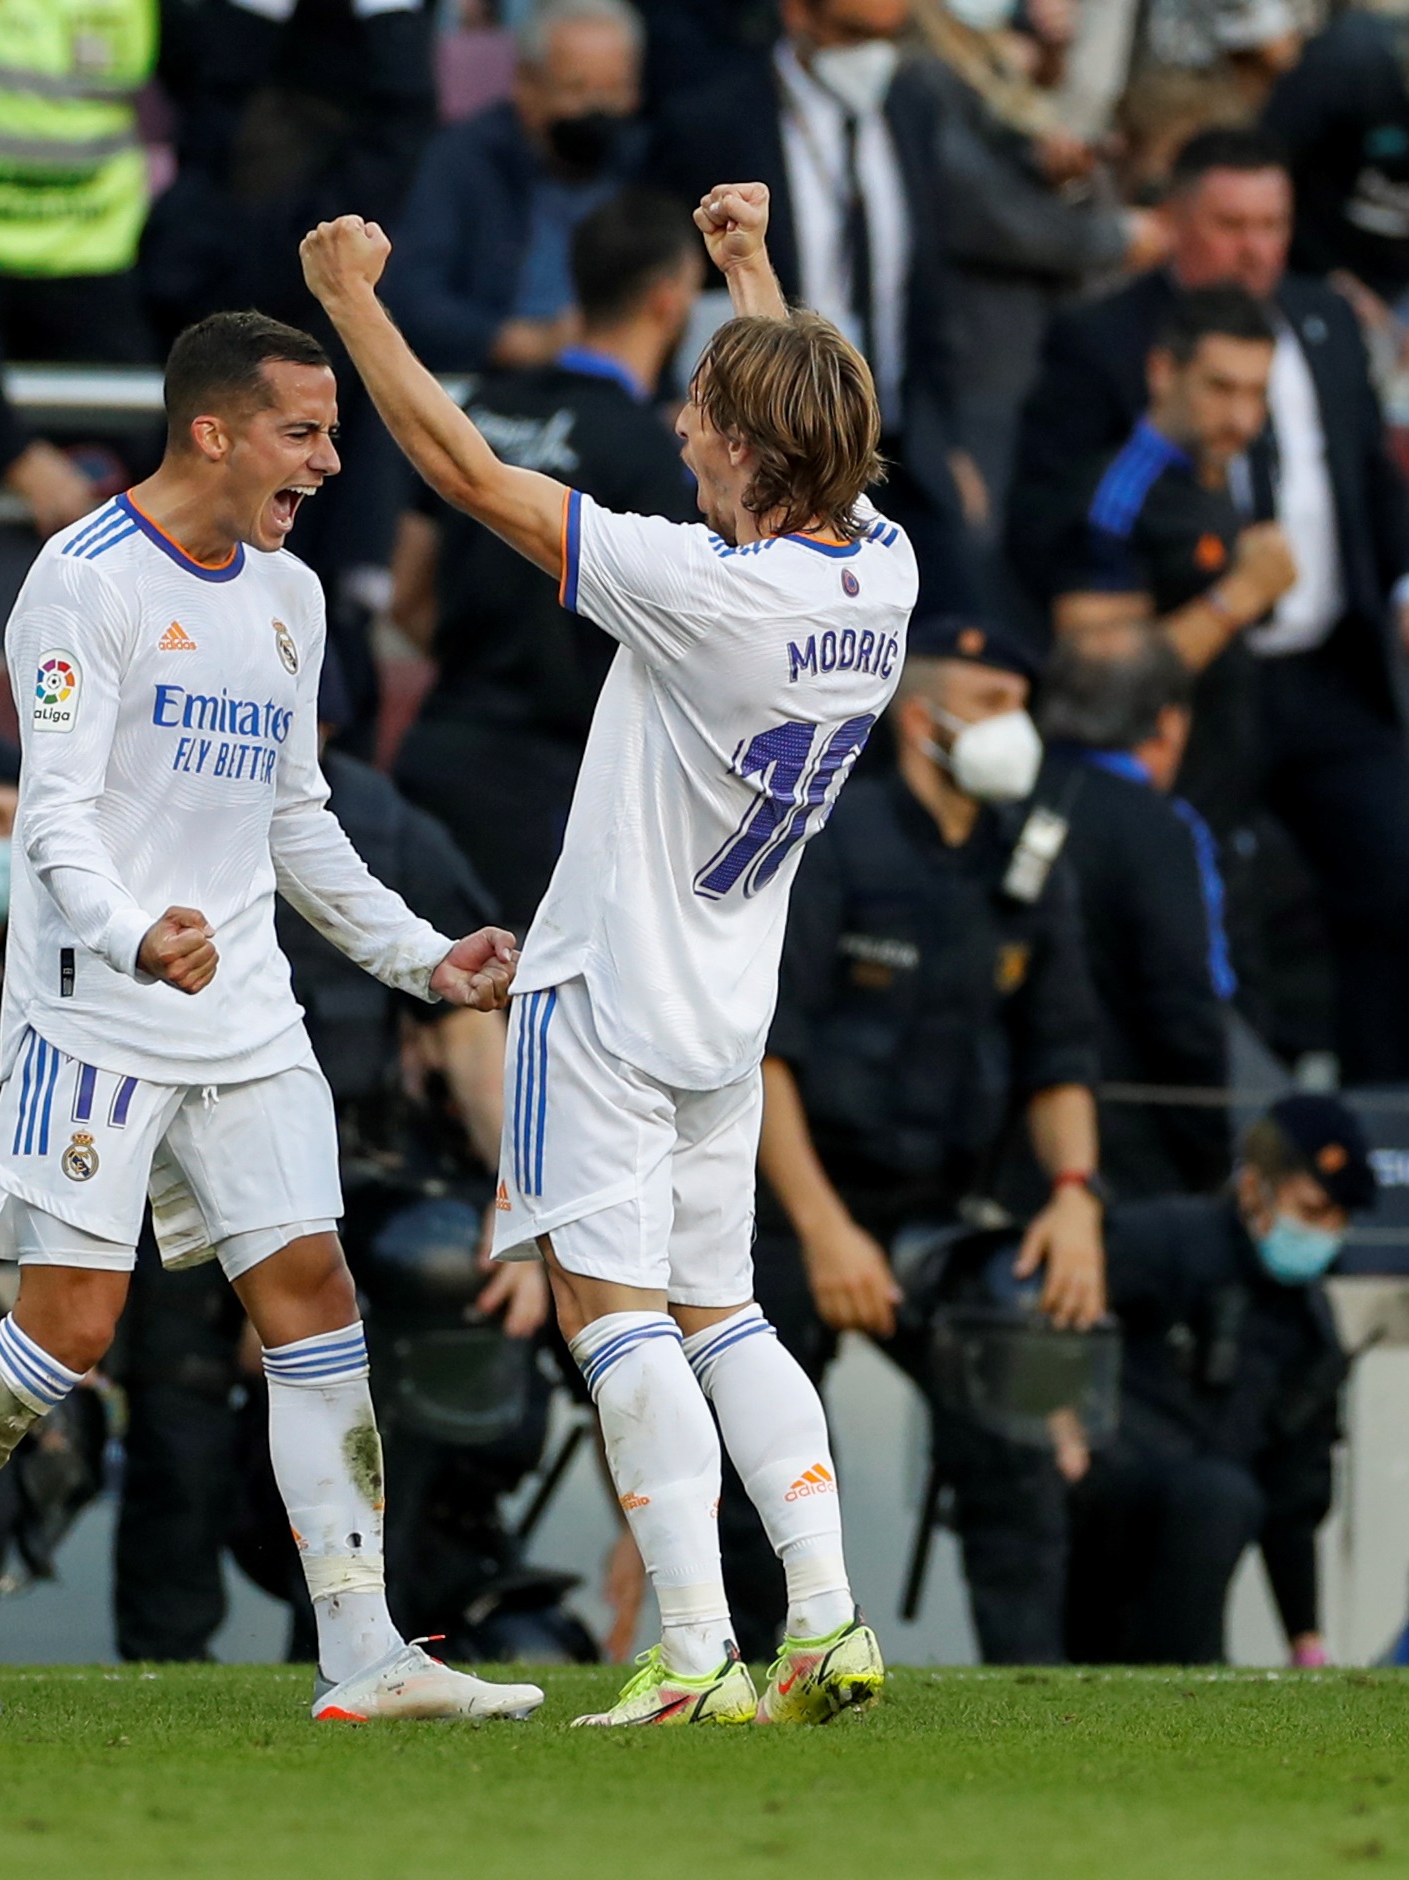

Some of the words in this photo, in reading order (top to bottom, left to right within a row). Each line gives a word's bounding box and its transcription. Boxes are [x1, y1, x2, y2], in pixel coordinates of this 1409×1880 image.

[158, 638, 197, 651] adidas
[787, 628, 898, 683] MODRIĆ
[152, 684, 294, 744] Emirates
[172, 736, 213, 774] FLY
